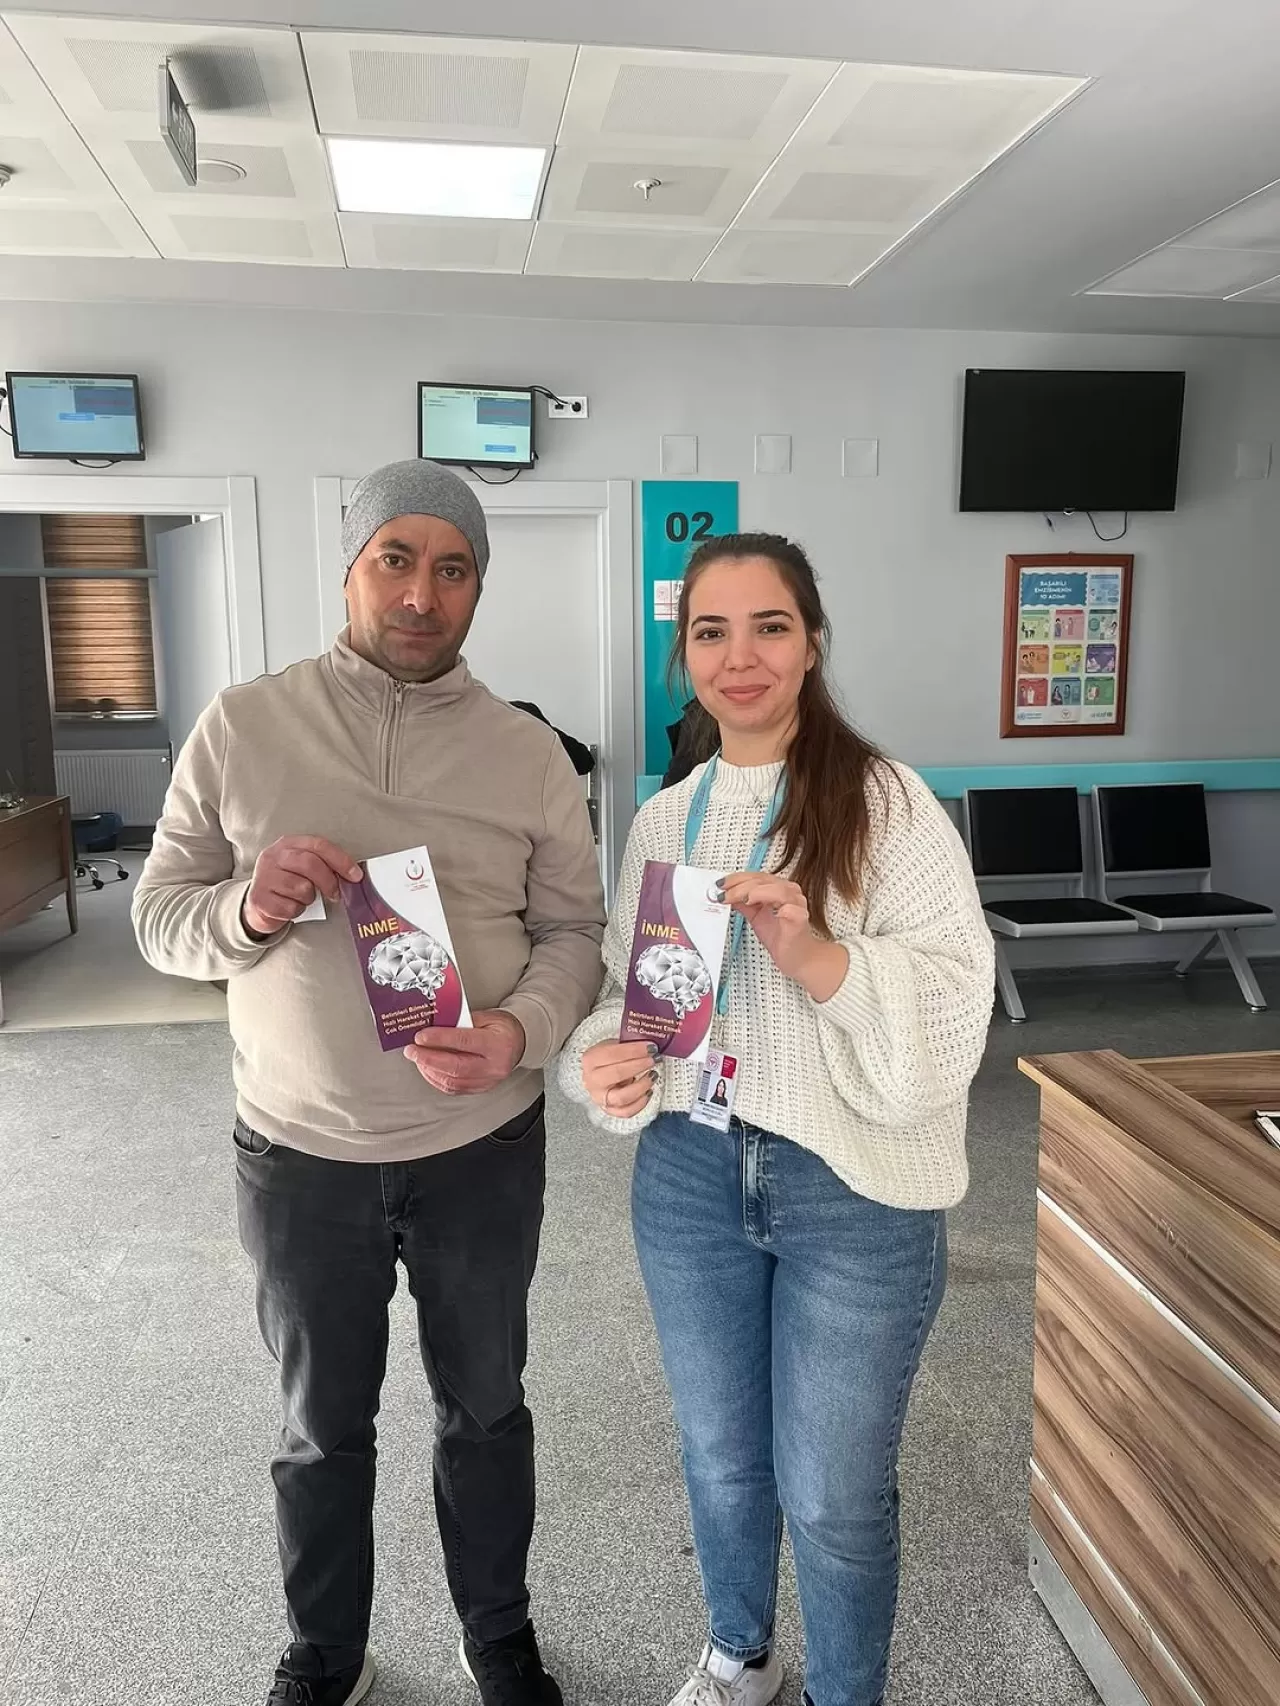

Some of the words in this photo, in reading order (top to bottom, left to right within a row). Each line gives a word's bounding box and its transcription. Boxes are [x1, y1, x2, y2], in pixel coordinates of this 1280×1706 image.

[666, 512, 714, 542] 02
[357, 917, 399, 939] İNME
[641, 919, 680, 940] İNME
